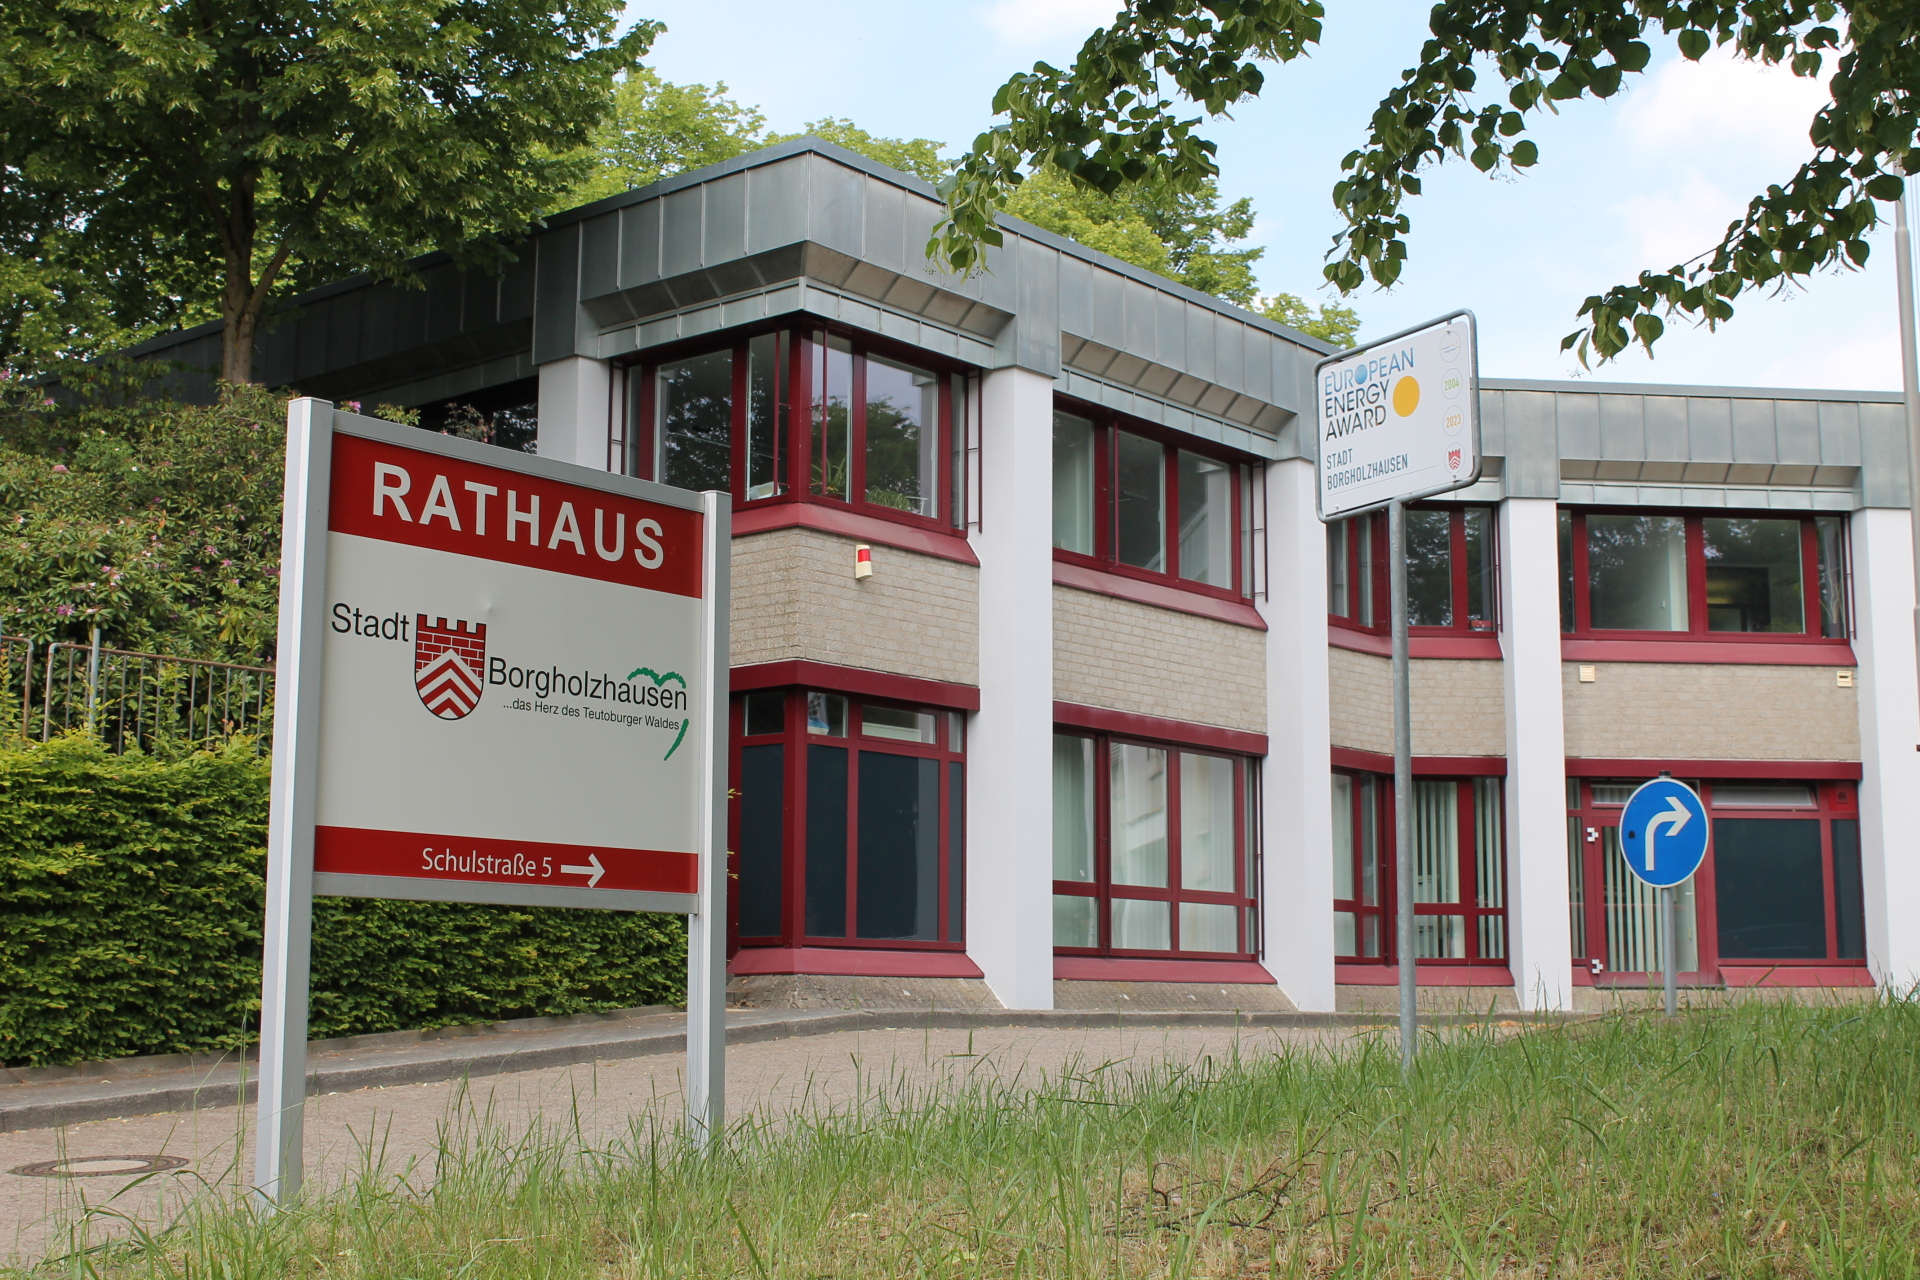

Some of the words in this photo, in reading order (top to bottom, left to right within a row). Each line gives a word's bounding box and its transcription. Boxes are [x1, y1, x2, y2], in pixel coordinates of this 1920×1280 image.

[1325, 379, 1390, 419] ENERGY
[1444, 376, 1460, 392] 2004
[1325, 405, 1387, 442] AWARD
[1445, 413, 1462, 429] 2023
[1326, 448, 1353, 470] STADT
[1327, 453, 1409, 491] BORGHOLZHAUSEN
[372, 461, 665, 569] RATHAUS
[331, 602, 410, 642] Stadt
[489, 656, 687, 711] Borgholzhausen
[534, 700, 559, 715] Herz
[561, 704, 580, 718] des
[583, 707, 643, 727] Teutoburger
[644, 715, 680, 730] Waldes
[421, 847, 537, 877] Schulstraße
[541, 856, 552, 878] 5
